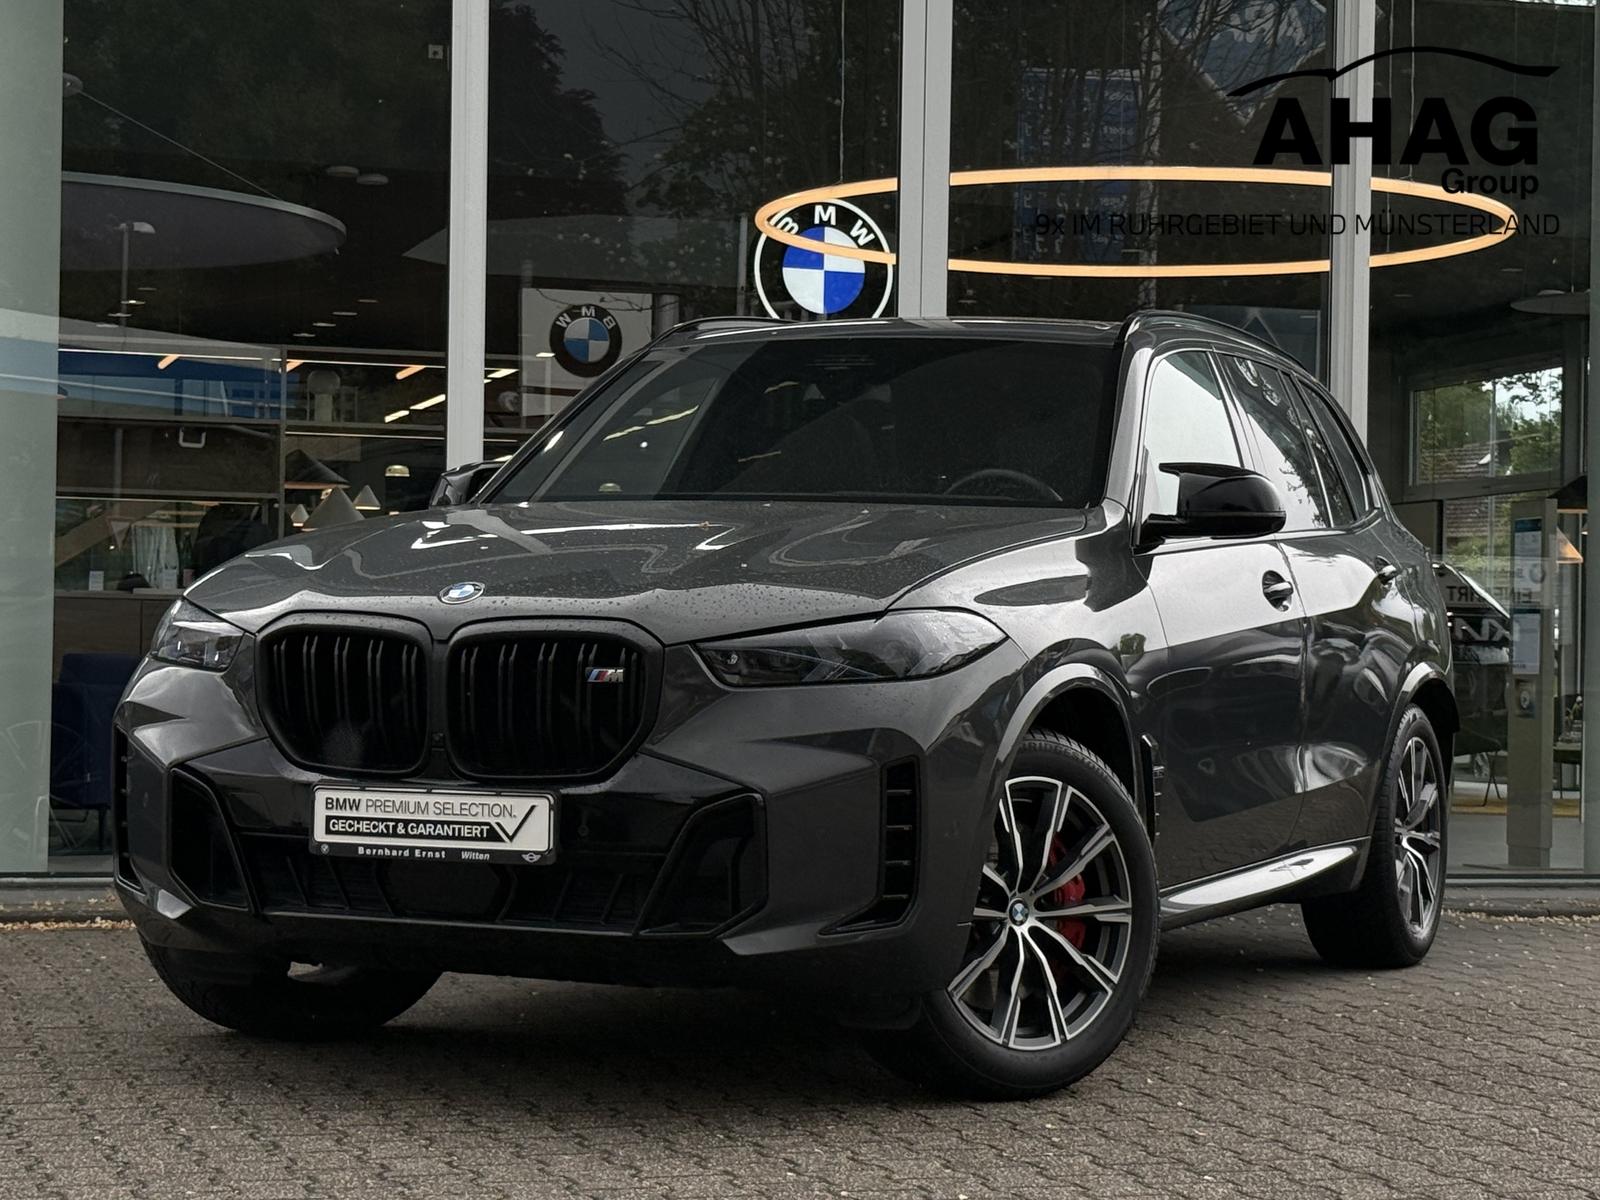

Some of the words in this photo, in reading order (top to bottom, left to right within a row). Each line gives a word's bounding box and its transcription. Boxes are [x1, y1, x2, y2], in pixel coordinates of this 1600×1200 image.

[325, 797, 361, 812] BMW
[365, 798, 430, 816] PREMIUM
[329, 819, 396, 834] GECHECKT
[396, 822, 406, 835] &
[407, 823, 490, 838] GARANTIERT
[358, 846, 410, 857] Bernhard
[415, 849, 446, 859] Ernst
[461, 851, 490, 861] Witten
